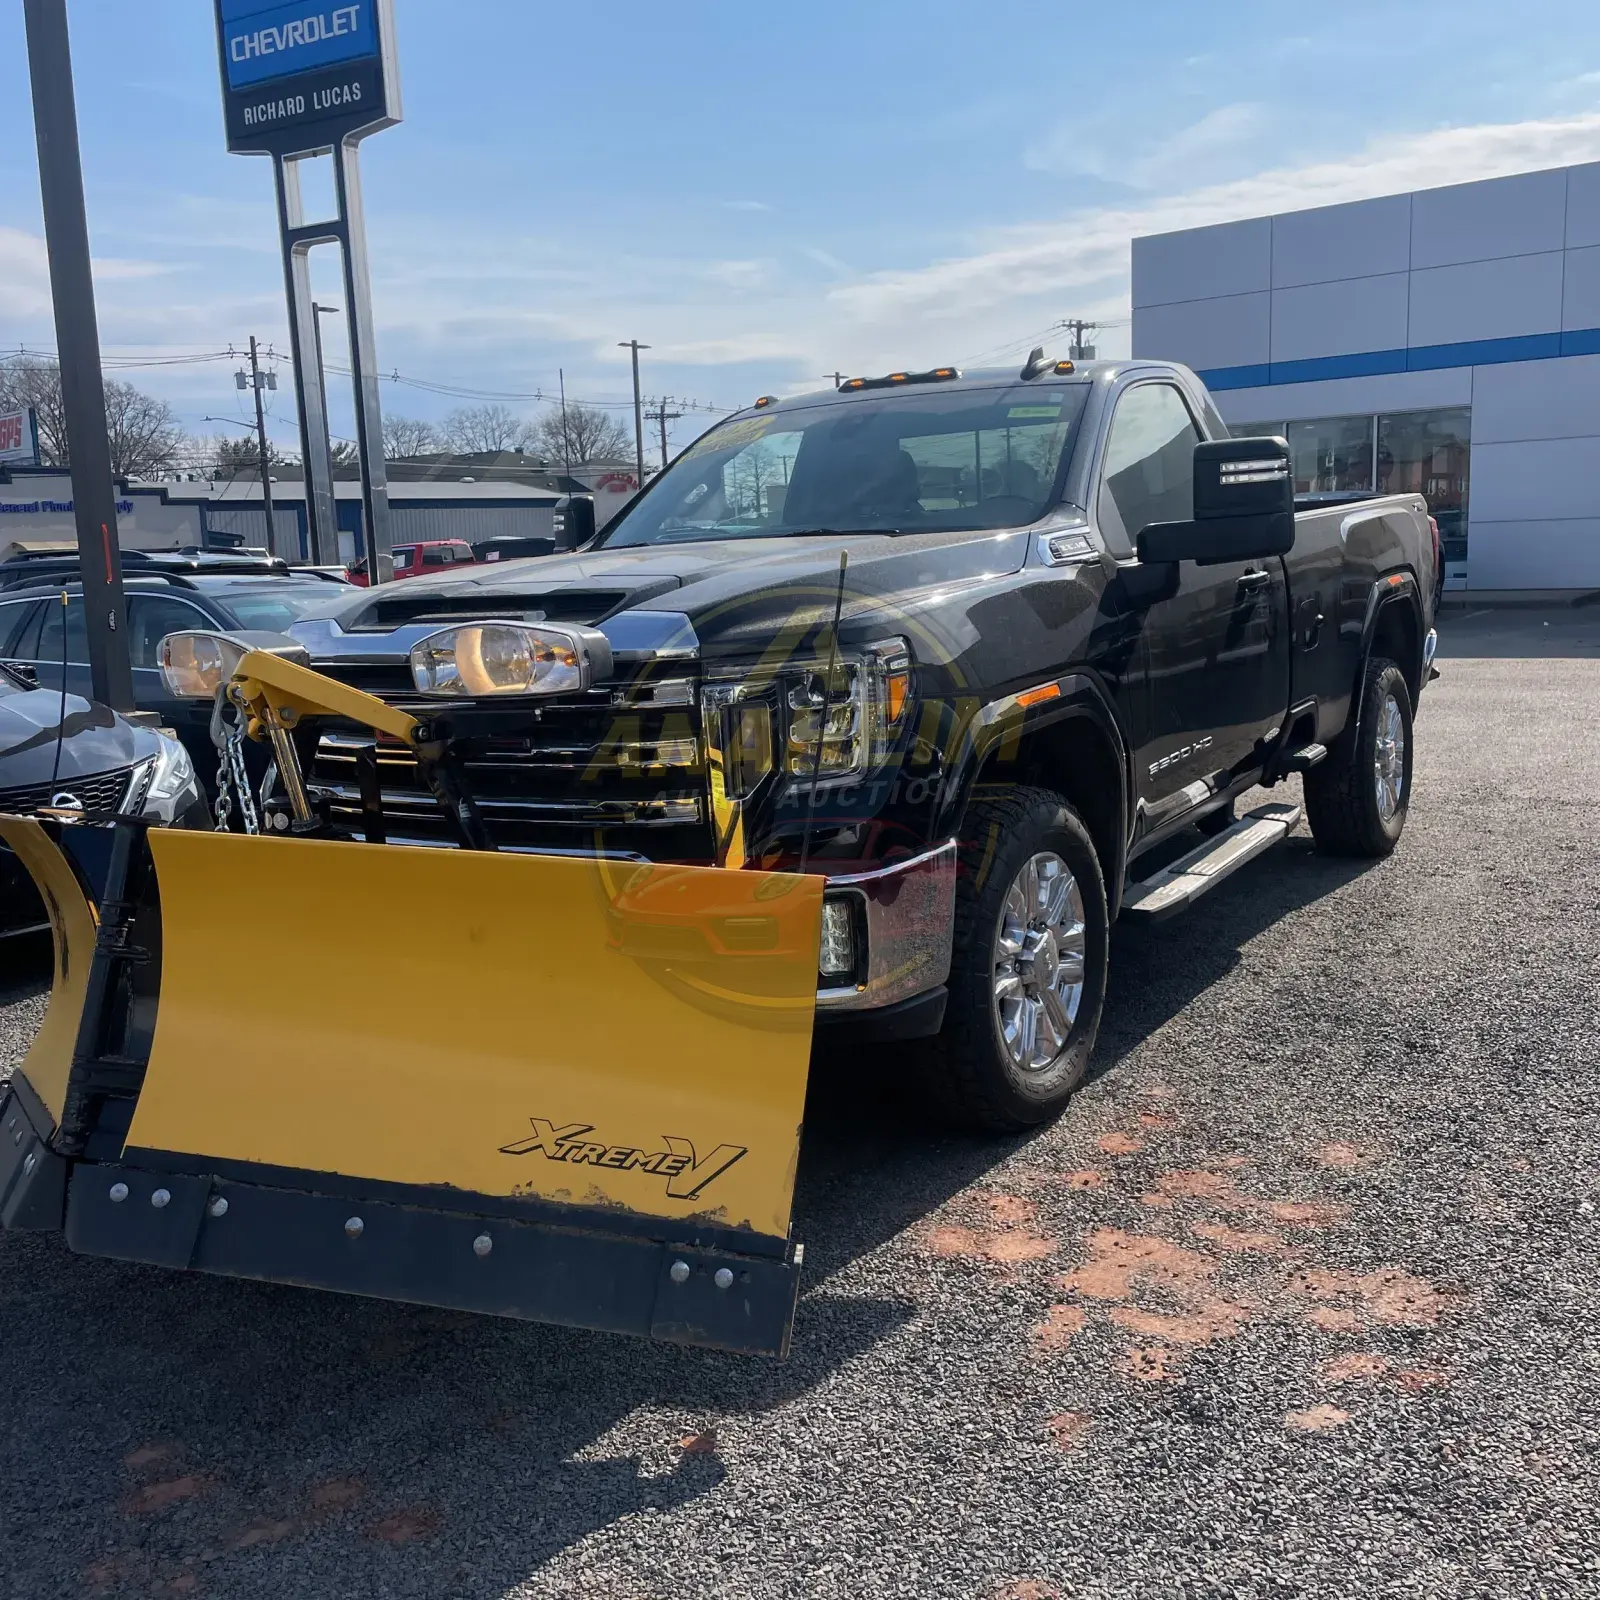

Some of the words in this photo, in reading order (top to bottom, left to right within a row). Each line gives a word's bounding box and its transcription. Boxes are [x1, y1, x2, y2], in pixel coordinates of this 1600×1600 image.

[230, 5, 361, 62] CHEVROLET
[243, 95, 306, 125] RICHARD
[312, 82, 362, 110] LUCAS
